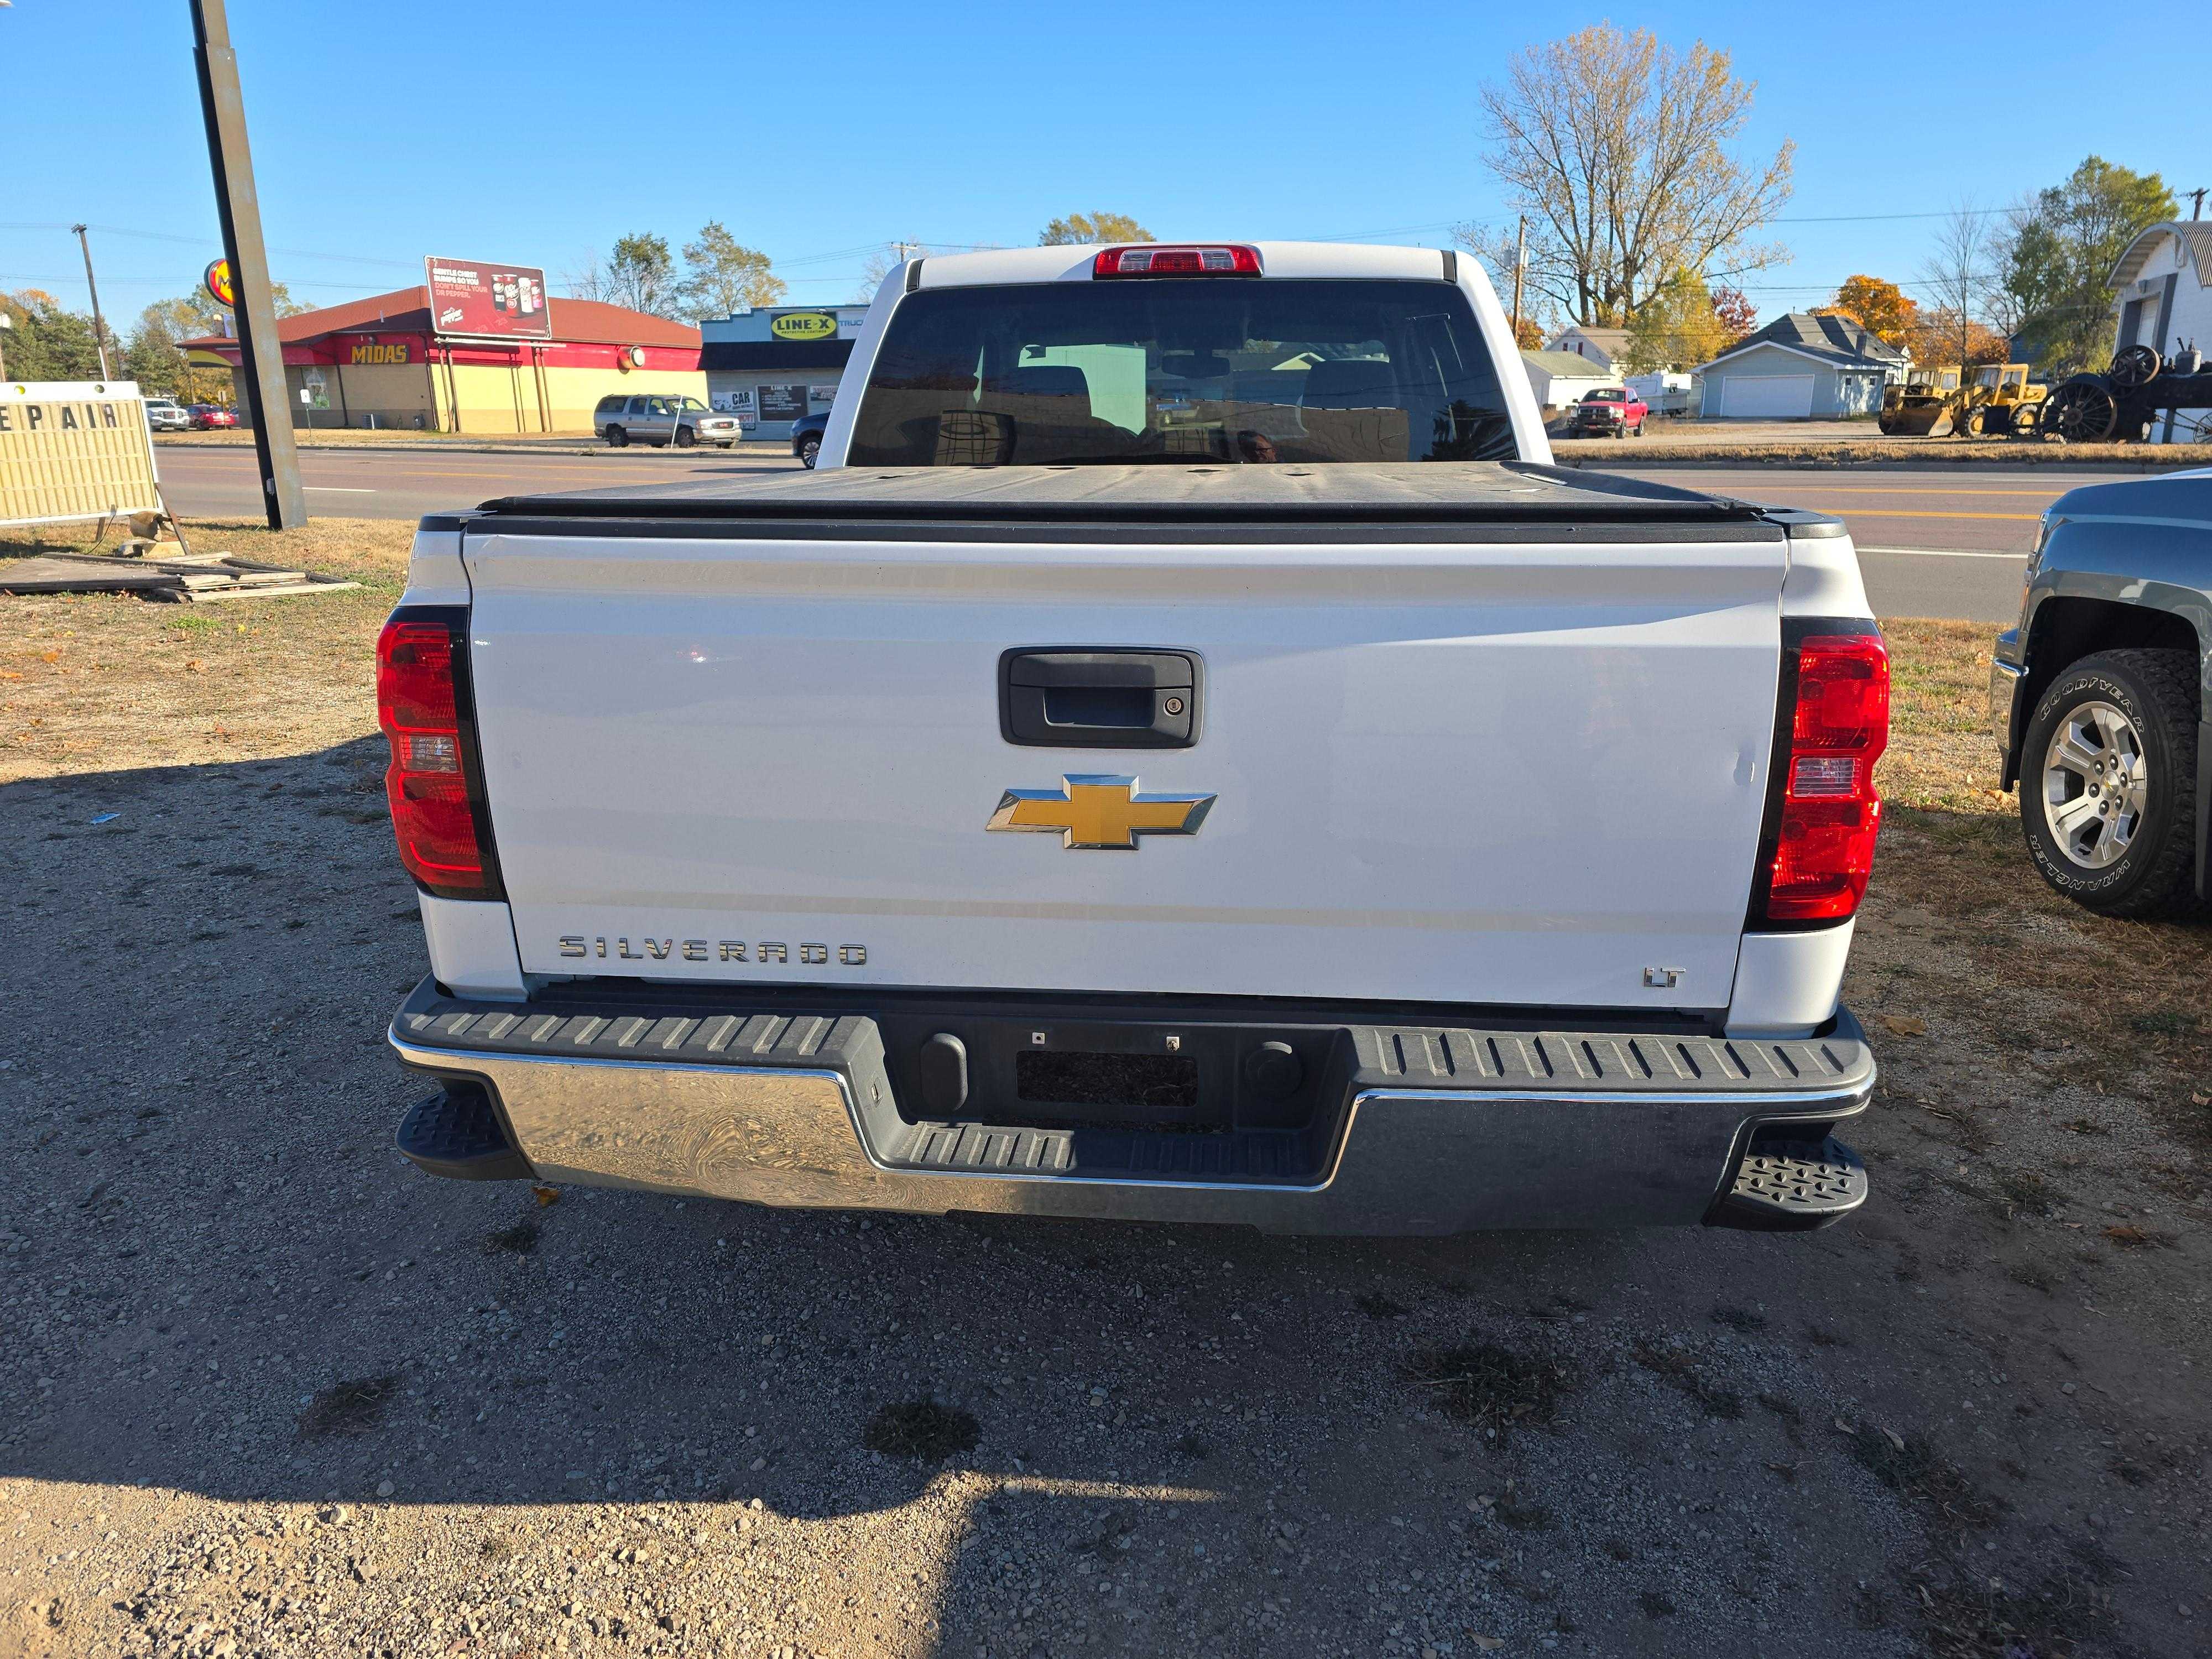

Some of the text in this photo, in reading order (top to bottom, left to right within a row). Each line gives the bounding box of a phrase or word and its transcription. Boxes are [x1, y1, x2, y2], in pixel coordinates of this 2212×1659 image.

[352, 345, 407, 363] MIDAS
[732, 392, 750, 405] CAR
[2040, 677, 2145, 733] GOODYEAR
[2030, 834, 2131, 891] WRANGLER
[559, 936, 867, 966] SILVERADO
[1644, 967, 1687, 988] LT
